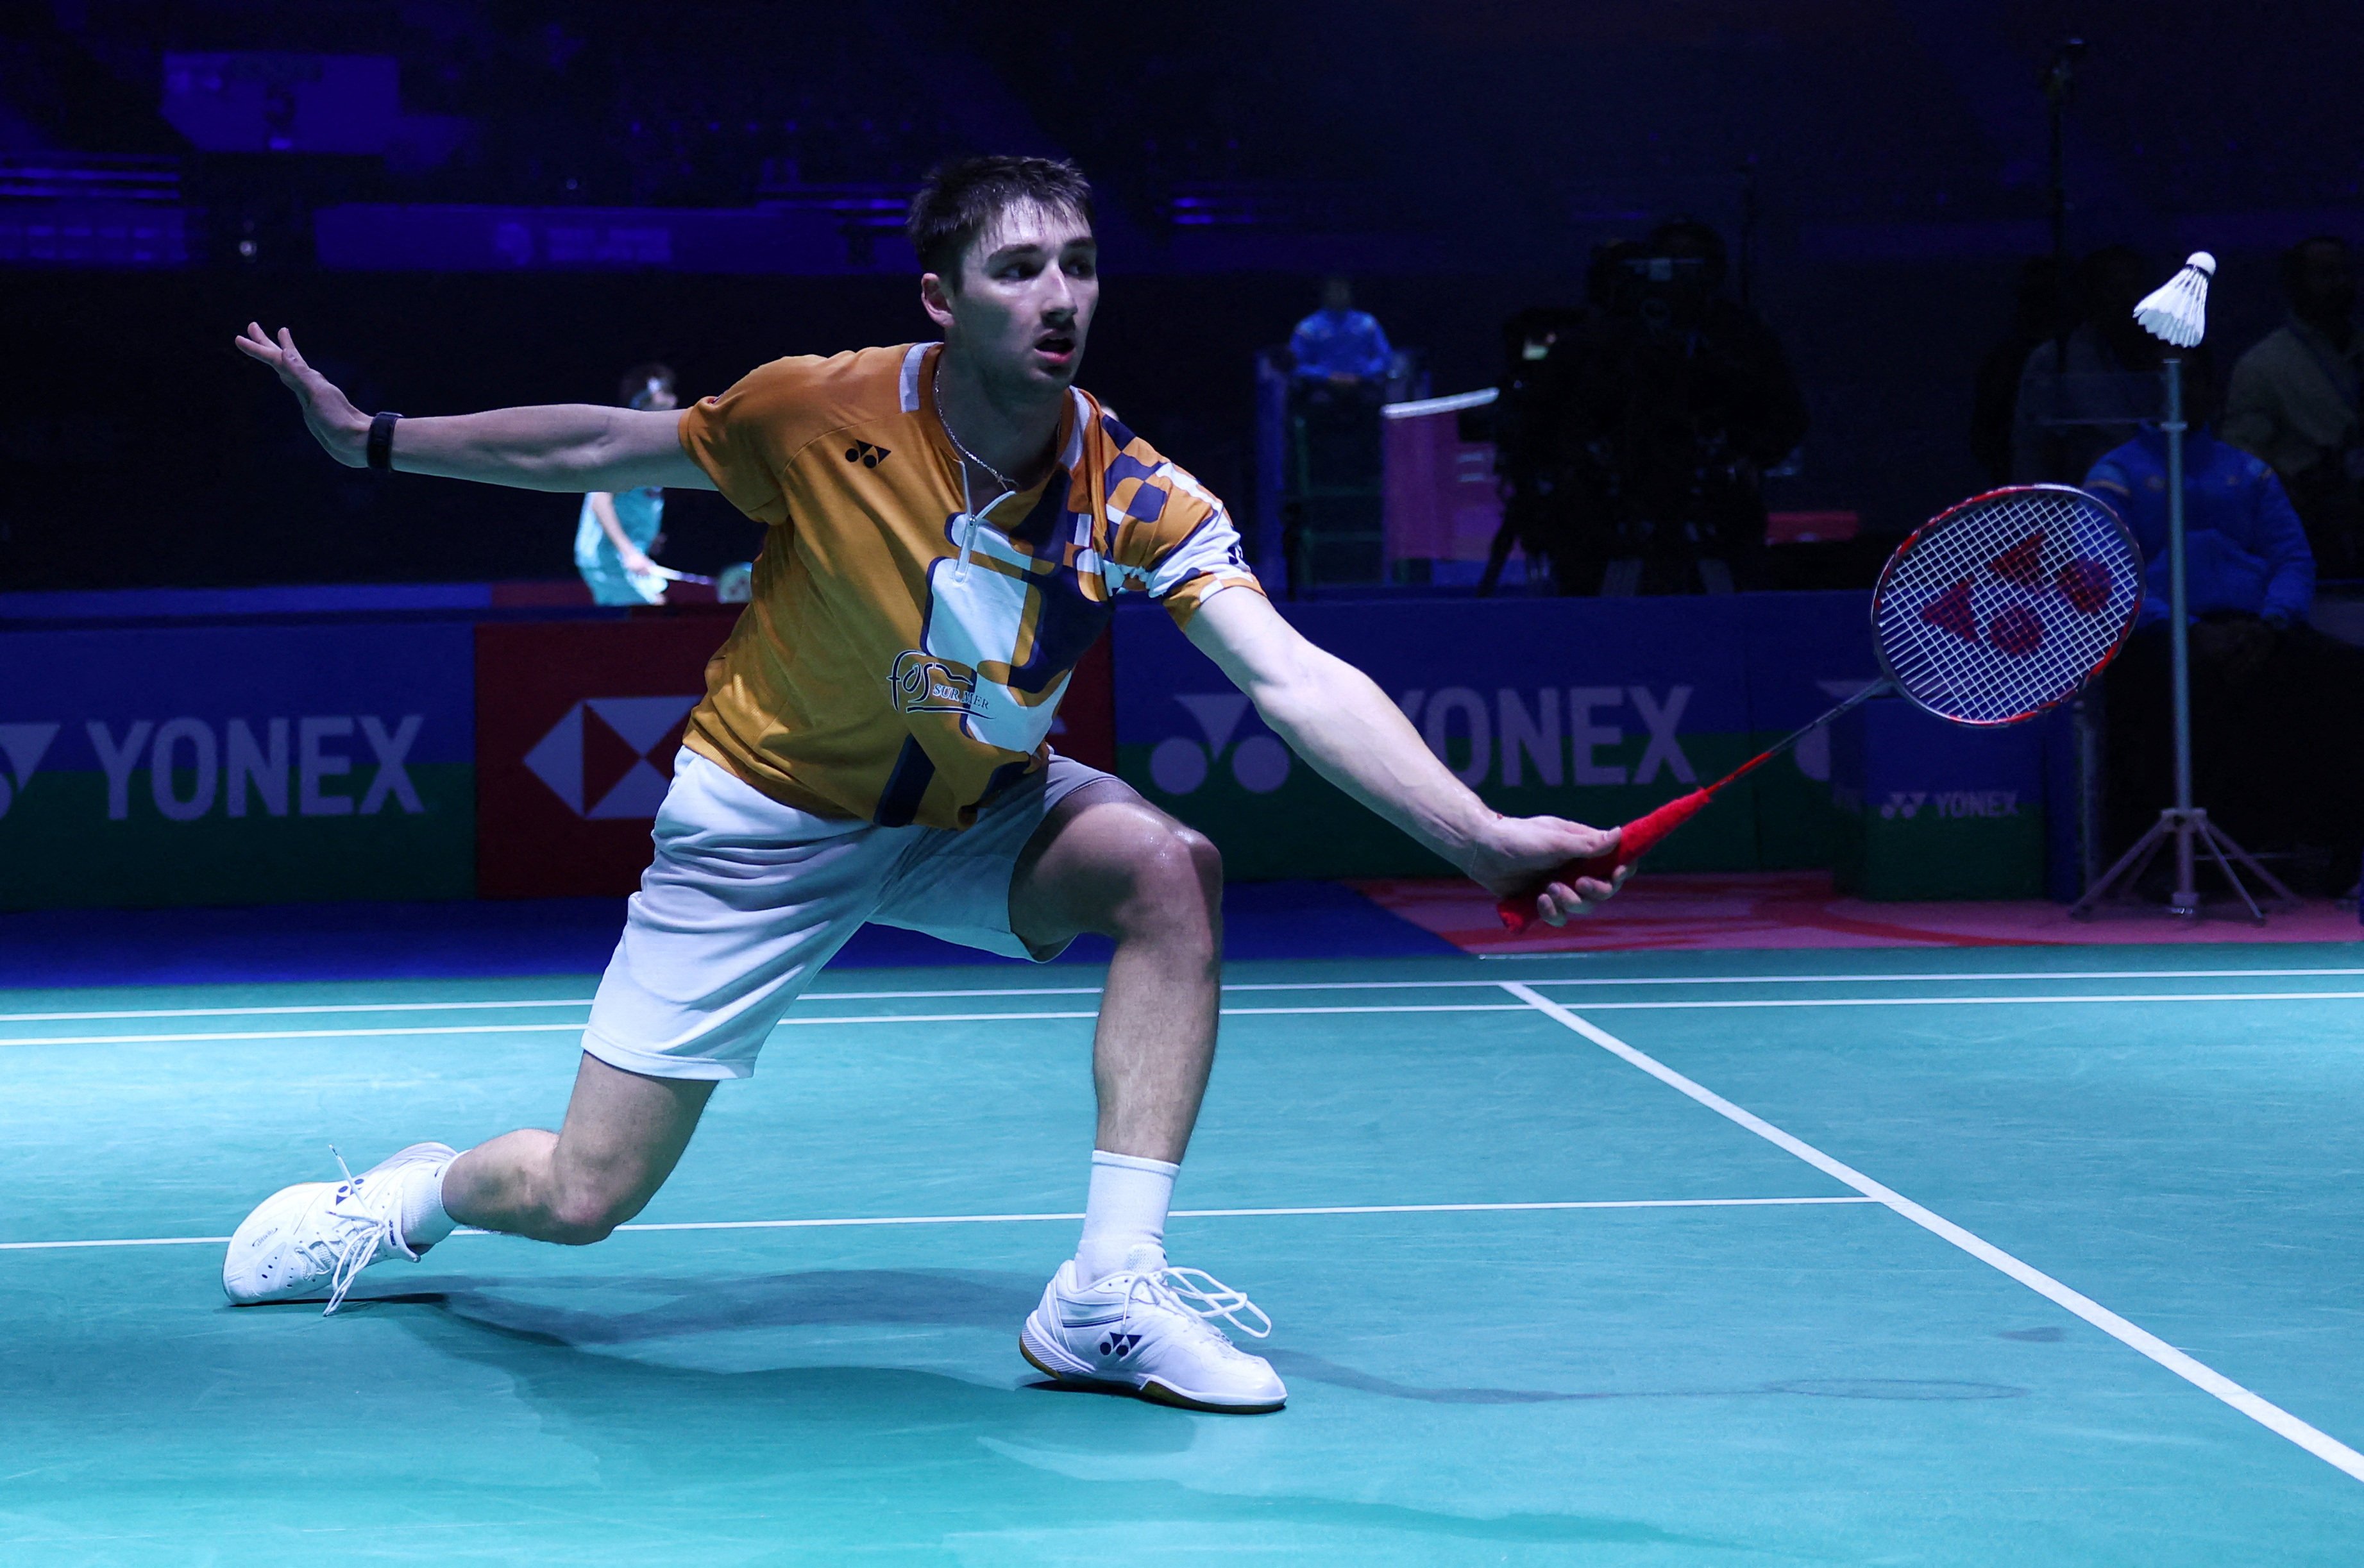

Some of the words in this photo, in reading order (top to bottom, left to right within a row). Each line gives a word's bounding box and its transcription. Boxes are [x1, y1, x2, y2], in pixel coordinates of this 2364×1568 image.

[934, 684, 960, 702] SUR
[963, 690, 990, 710] MER
[85, 714, 426, 821] YONEX
[1934, 789, 2019, 818] YONEX
